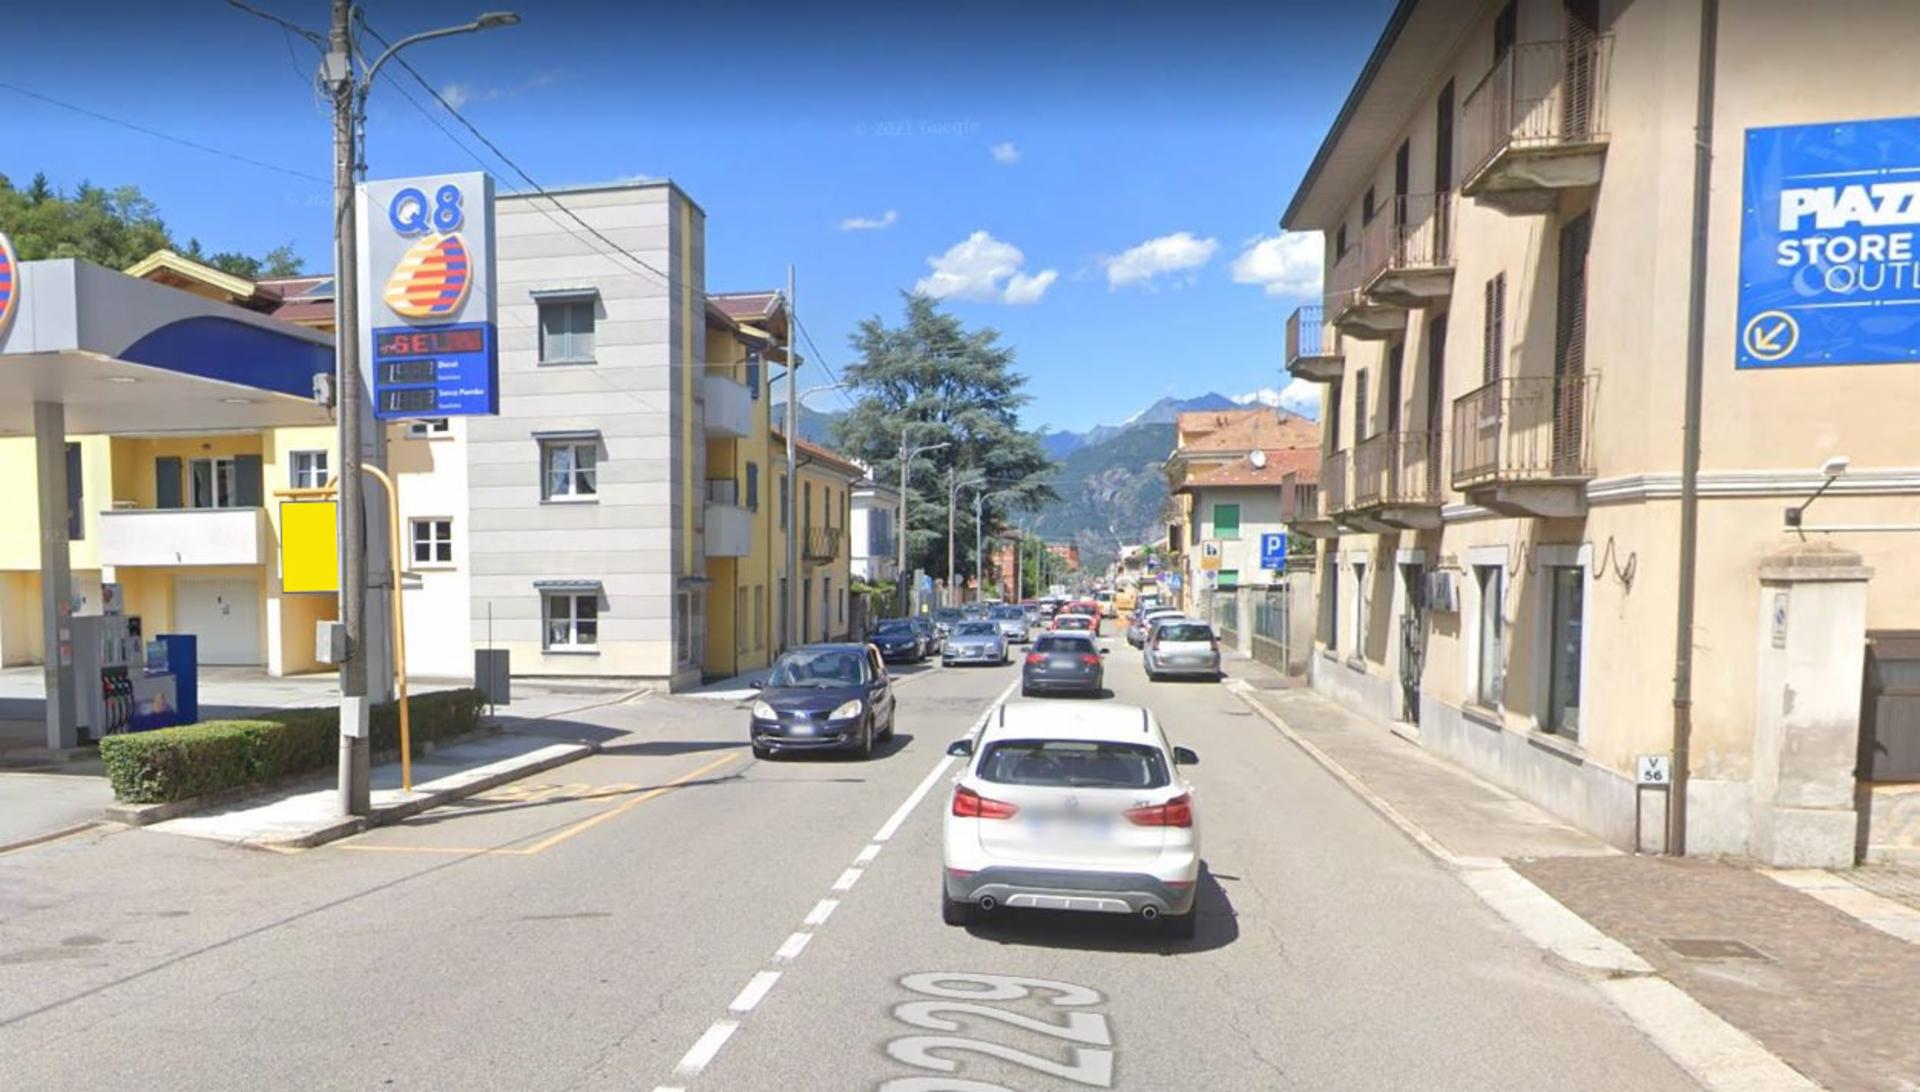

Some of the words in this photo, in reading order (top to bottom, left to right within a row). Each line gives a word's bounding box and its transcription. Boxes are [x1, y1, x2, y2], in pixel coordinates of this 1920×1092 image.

[389, 184, 464, 235] Q8
[1777, 232, 1913, 266] STORE
[1267, 536, 1281, 555] P
[1648, 758, 1659, 768] V
[1644, 770, 1663, 781] 56
